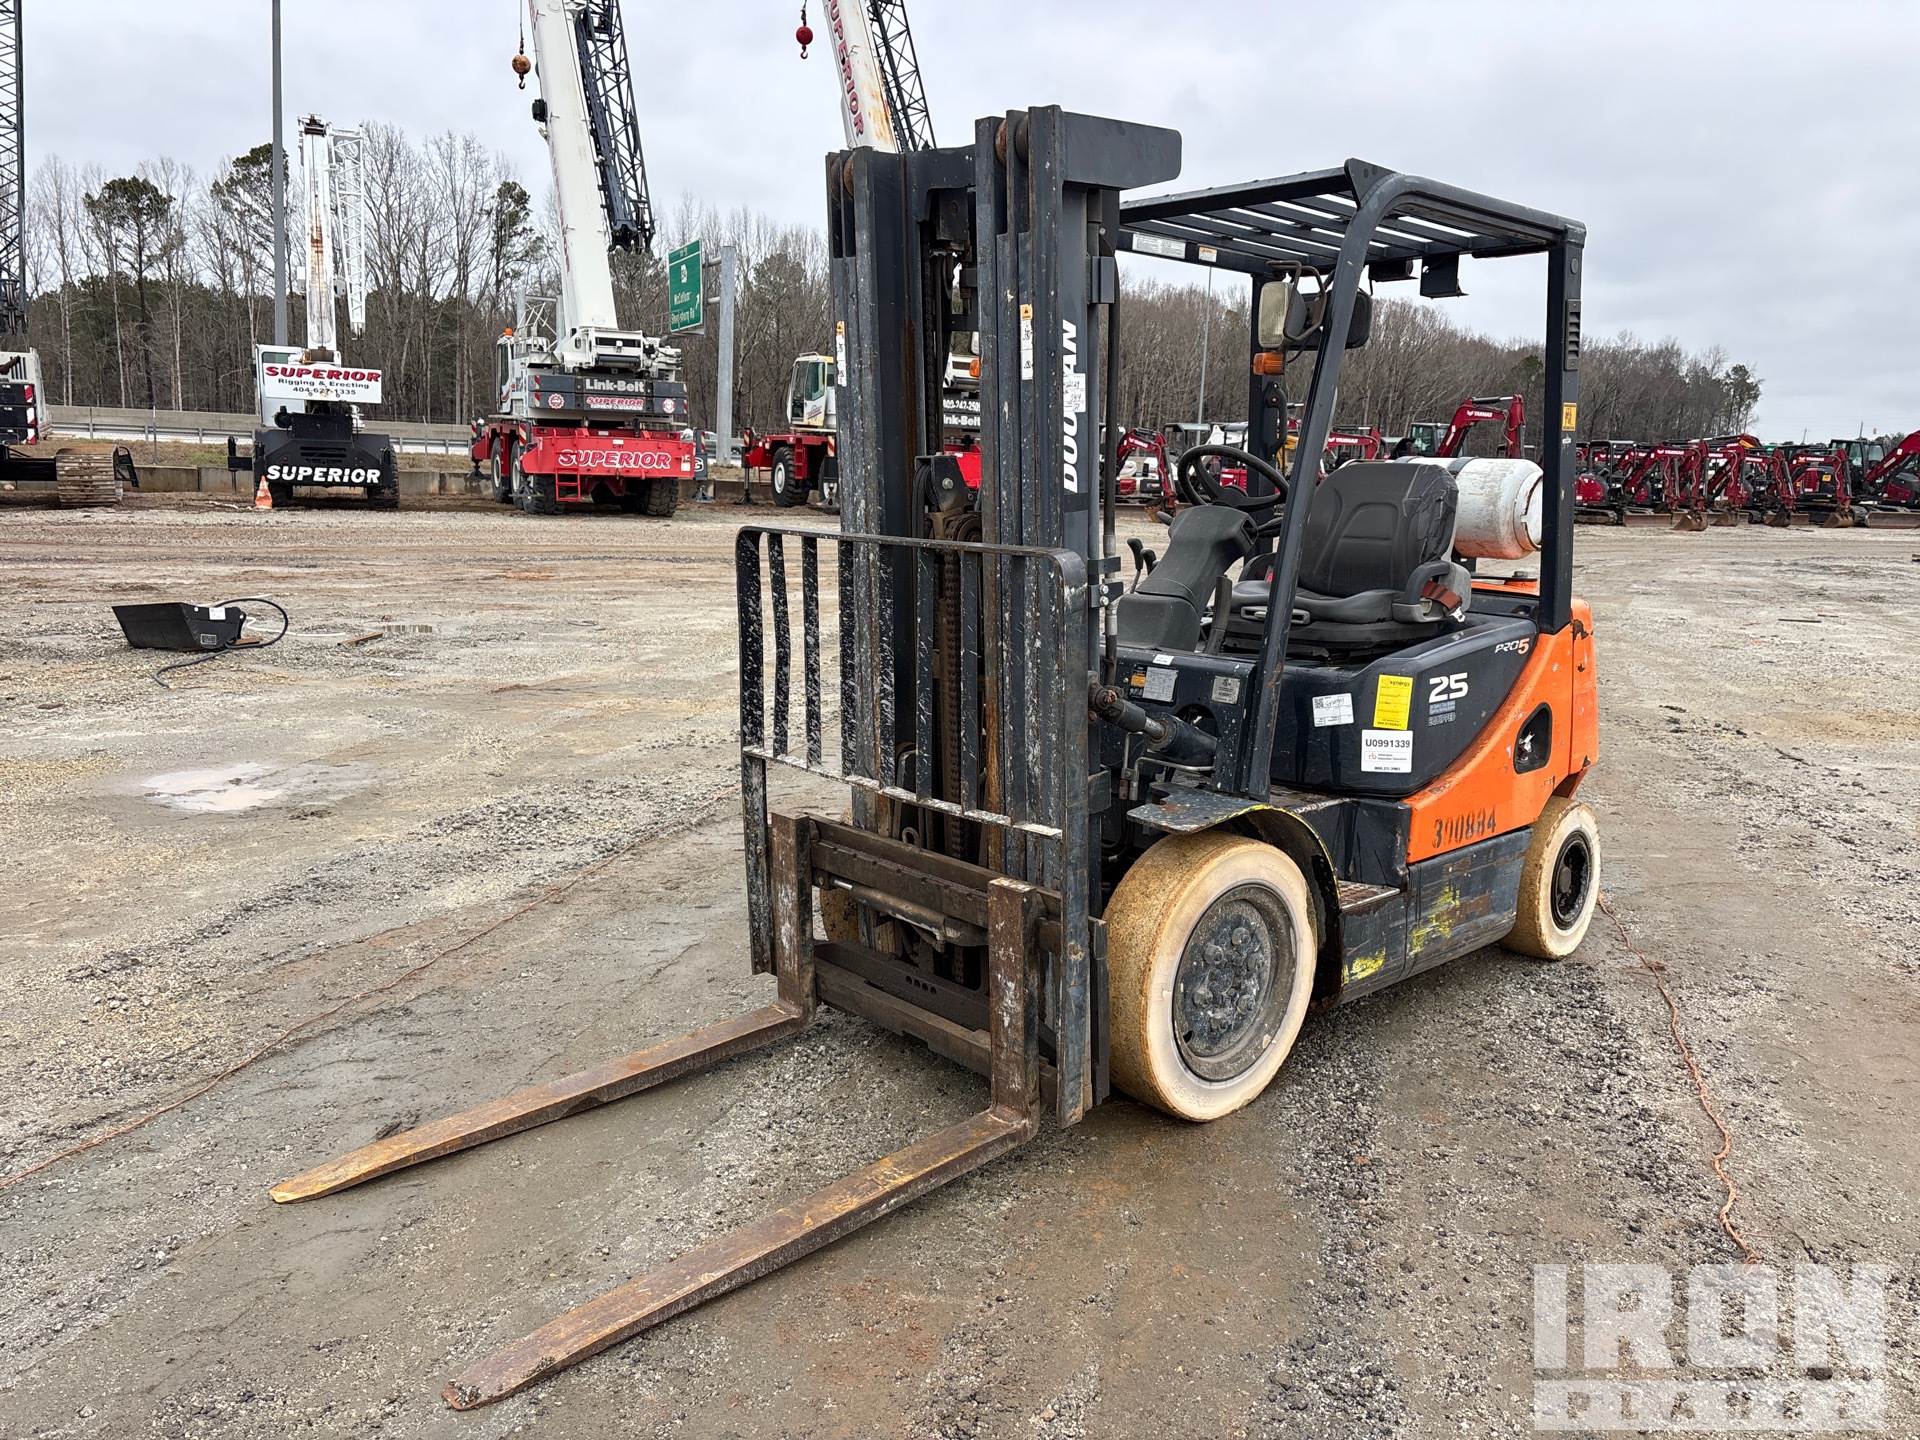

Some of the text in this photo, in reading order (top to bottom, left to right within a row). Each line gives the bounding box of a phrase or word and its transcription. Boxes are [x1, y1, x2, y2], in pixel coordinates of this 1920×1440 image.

[829, 0, 863, 137] UPERIOR
[265, 366, 381, 382] SUPERIOR
[278, 378, 315, 386] Rigging
[329, 381, 370, 389] Erecting
[585, 378, 645, 393] Link-Belt
[586, 396, 644, 407] SUPERIOR
[1063, 319, 1078, 494] DOOAN
[943, 414, 980, 426] ink-Belt
[1474, 410, 1493, 418] YANMAR
[558, 449, 672, 470] SUPERIOR
[267, 464, 380, 483] SUPERIOR
[1428, 672, 1468, 703] 25
[1365, 739, 1411, 748] U0991339
